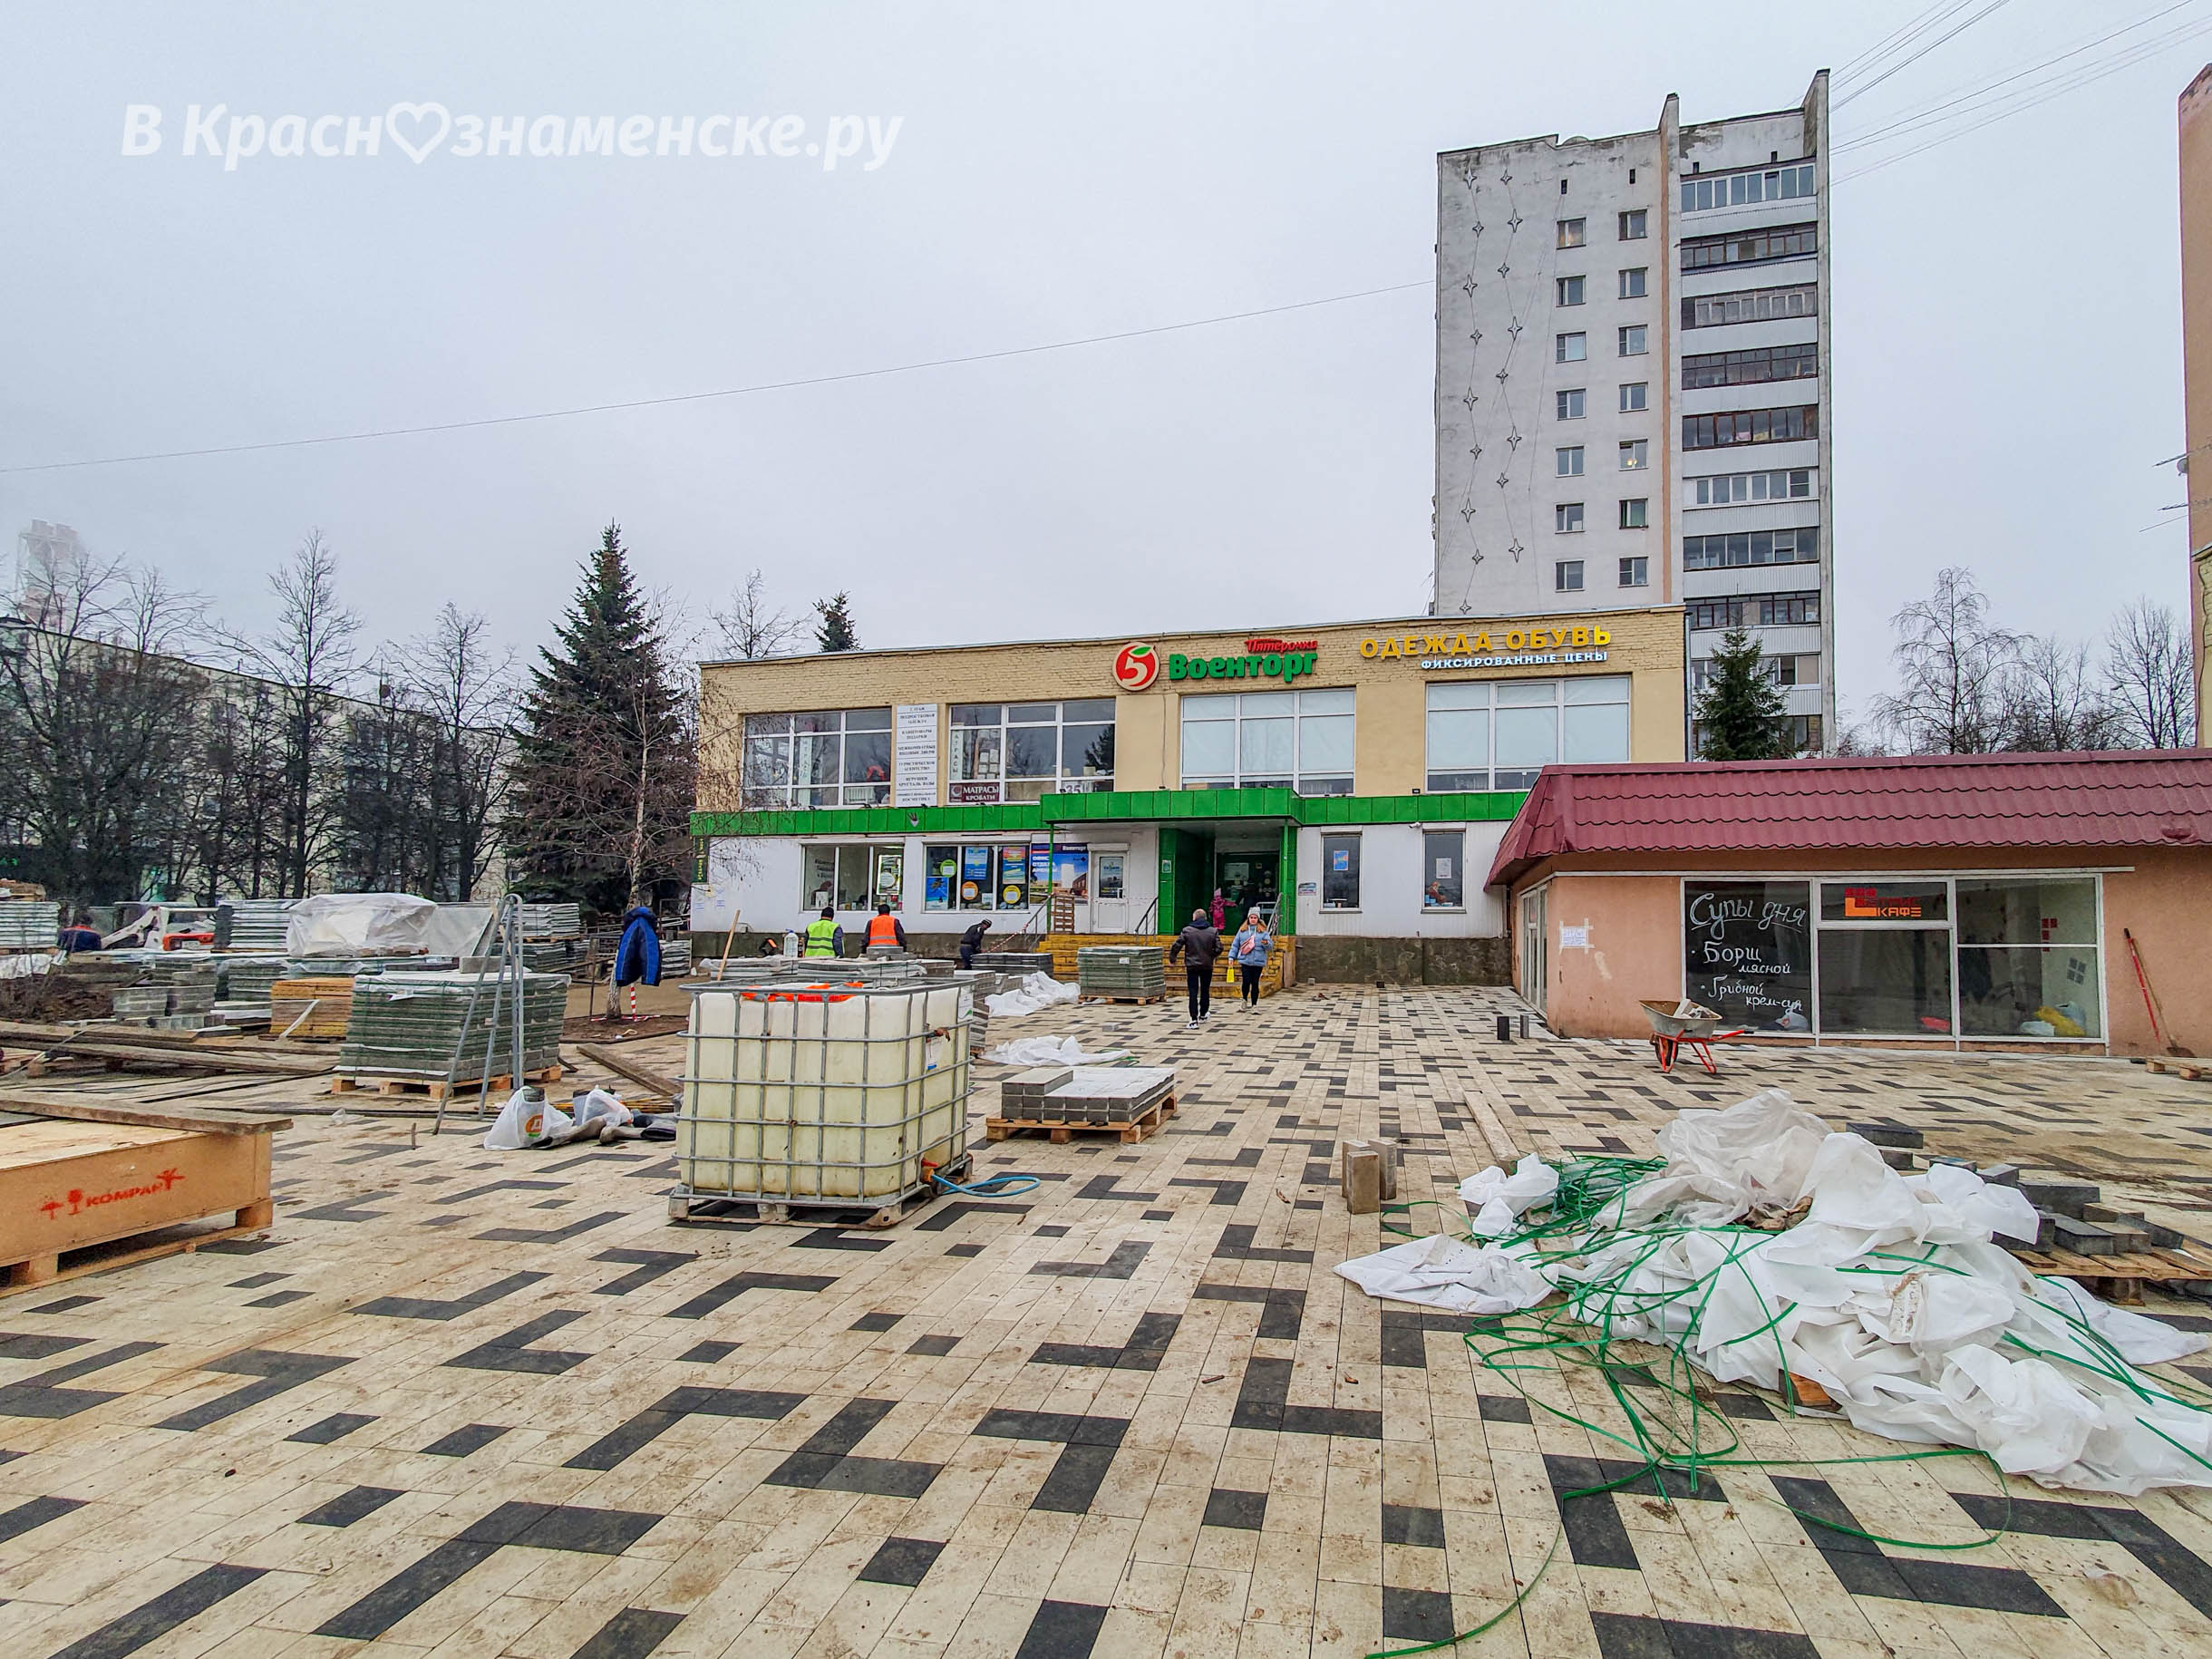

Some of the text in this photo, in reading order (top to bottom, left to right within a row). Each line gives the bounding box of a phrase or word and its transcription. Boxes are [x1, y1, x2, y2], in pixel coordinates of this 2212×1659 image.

[1360, 626, 1612, 660] ОДЕЖДА ОБУВЬ
[1169, 652, 1318, 683] Военторг
[1421, 650, 1608, 670] ФИКСИРОВАННЫЕ ЦЕНЫ
[963, 785, 999, 795] МАТРАСЫ
[1689, 892, 1807, 940] Супы дня
[1877, 907, 1922, 917] КАФЕ
[1703, 940, 1762, 967] Борщ
[1738, 962, 1791, 975] мясной
[1708, 974, 1764, 1002] Грибной
